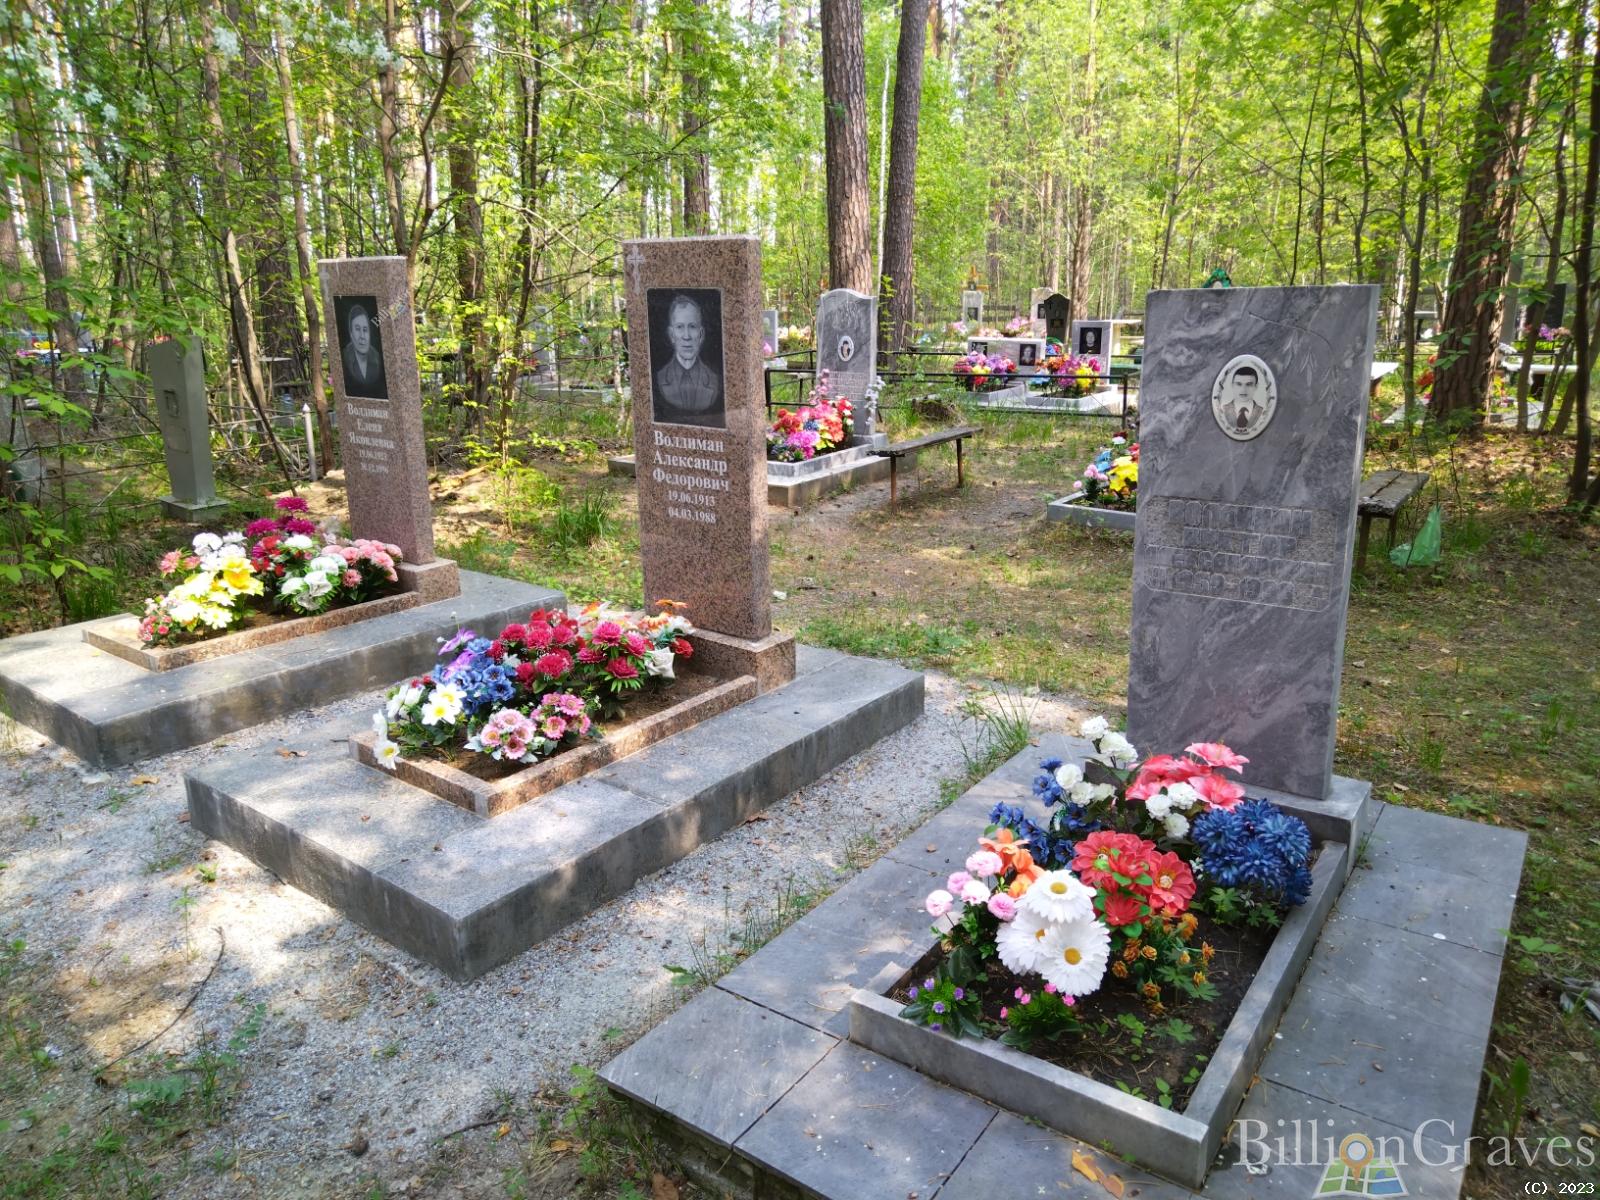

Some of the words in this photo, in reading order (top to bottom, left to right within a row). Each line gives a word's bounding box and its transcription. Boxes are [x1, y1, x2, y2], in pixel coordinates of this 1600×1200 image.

[654, 430, 724, 453] Волдиман
[653, 449, 728, 476] Александр
[652, 467, 729, 492] Федорович
[668, 490, 716, 507] 19.06.1913
[668, 506, 717, 524] 04.03.1988
